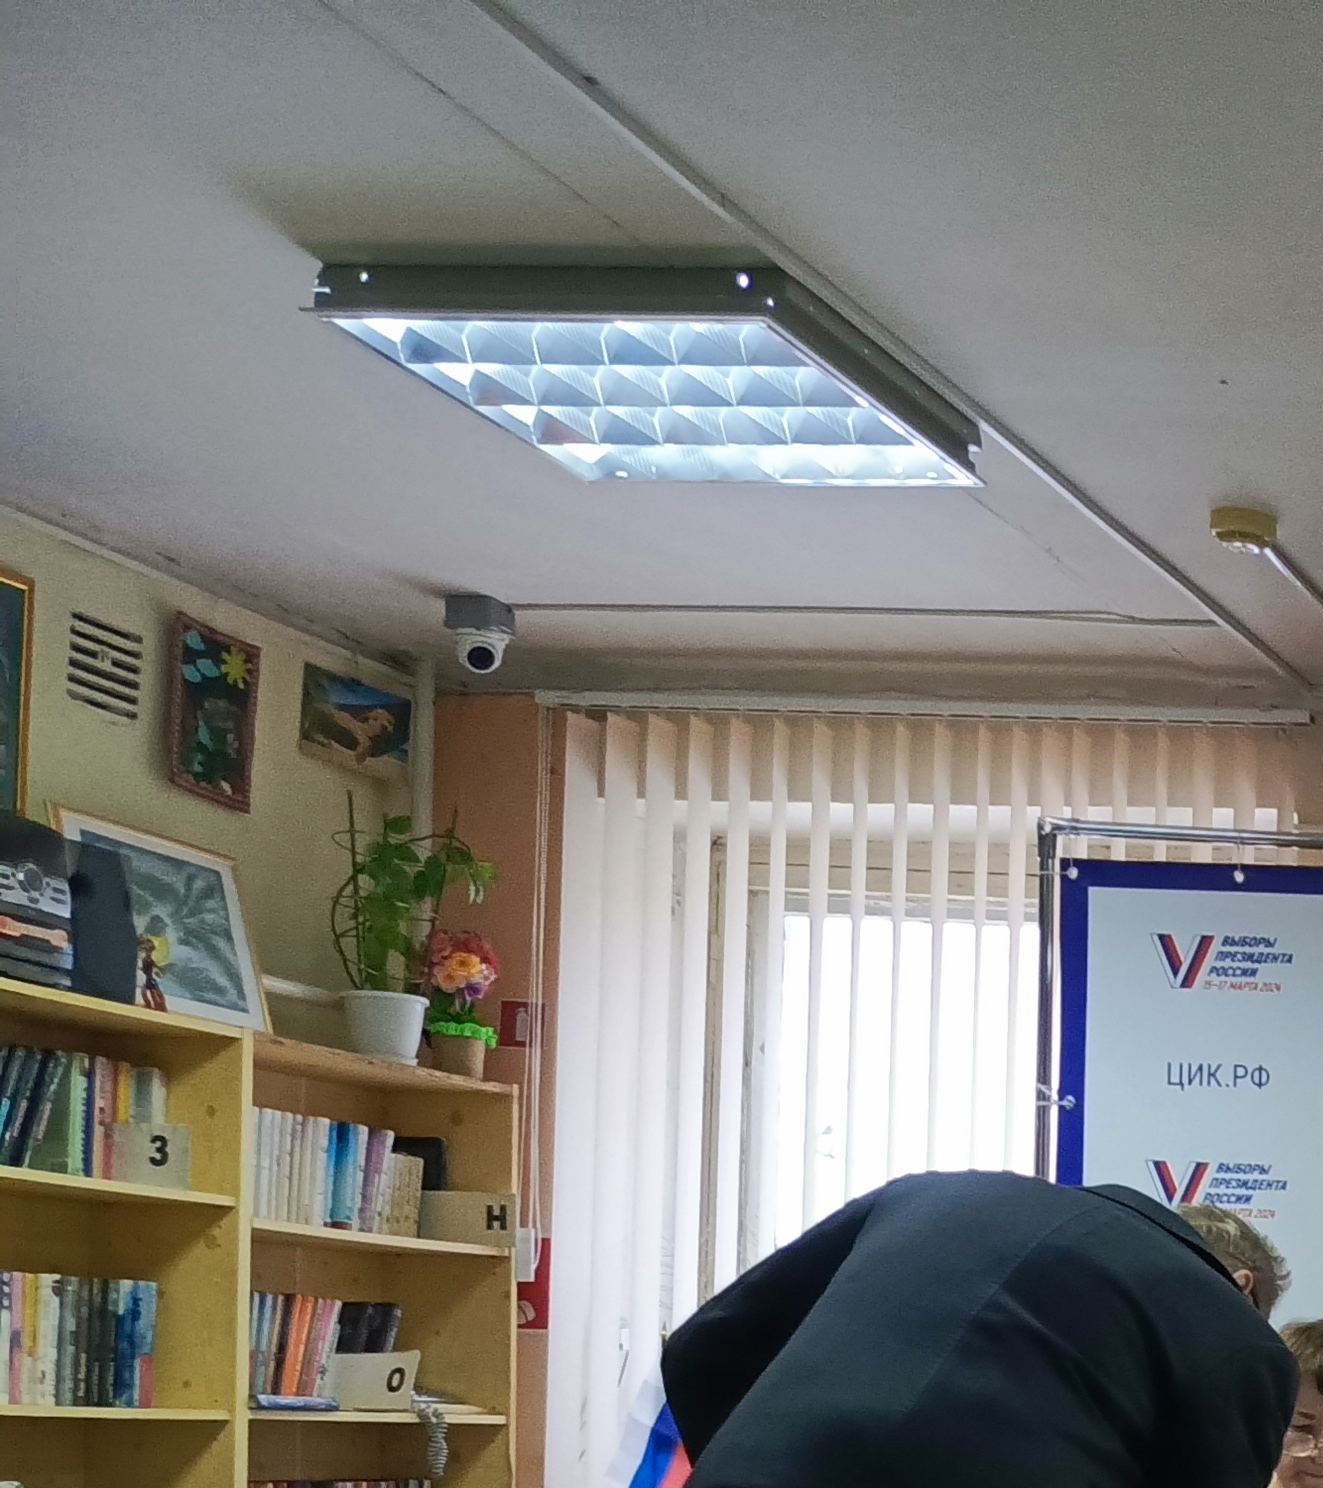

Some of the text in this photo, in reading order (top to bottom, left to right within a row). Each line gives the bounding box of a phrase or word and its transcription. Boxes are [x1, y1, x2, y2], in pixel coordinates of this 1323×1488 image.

[1221, 935, 1278, 948] ВЫБОРЫ
[1214, 950, 1293, 965] ПРЕЗИДЕНТА
[1207, 966, 1259, 978] РОССИИ
[1167, 1061, 1271, 1089] ЦИК.РФ
[1215, 1162, 1271, 1175] ВЫБОРЫ
[1208, 1177, 1287, 1191] ПРЕЗИДЕНТА
[1202, 1192, 1253, 1205] РОССИИ
